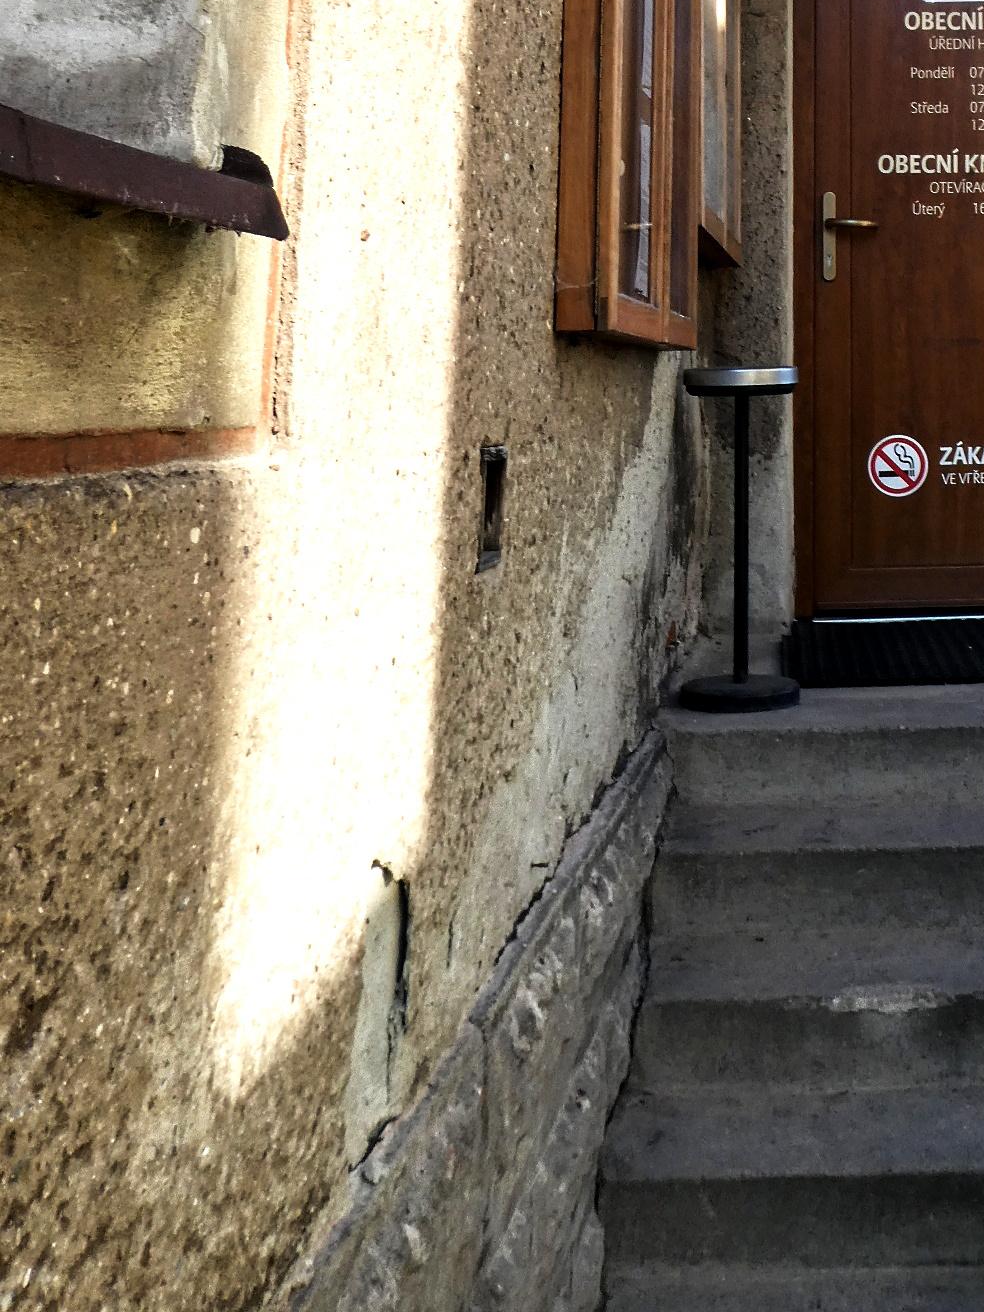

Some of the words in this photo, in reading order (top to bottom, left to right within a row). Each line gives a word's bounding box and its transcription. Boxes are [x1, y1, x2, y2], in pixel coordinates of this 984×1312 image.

[904, 7, 984, 30] OBECNÍ
[929, 36, 975, 50] ÚŘEDNÍ
[910, 67, 955, 79] Pondělí
[911, 102, 949, 114] Středa
[878, 148, 959, 174] OBECNÍ
[912, 200, 945, 218] Úterý
[941, 473, 956, 485] VE
